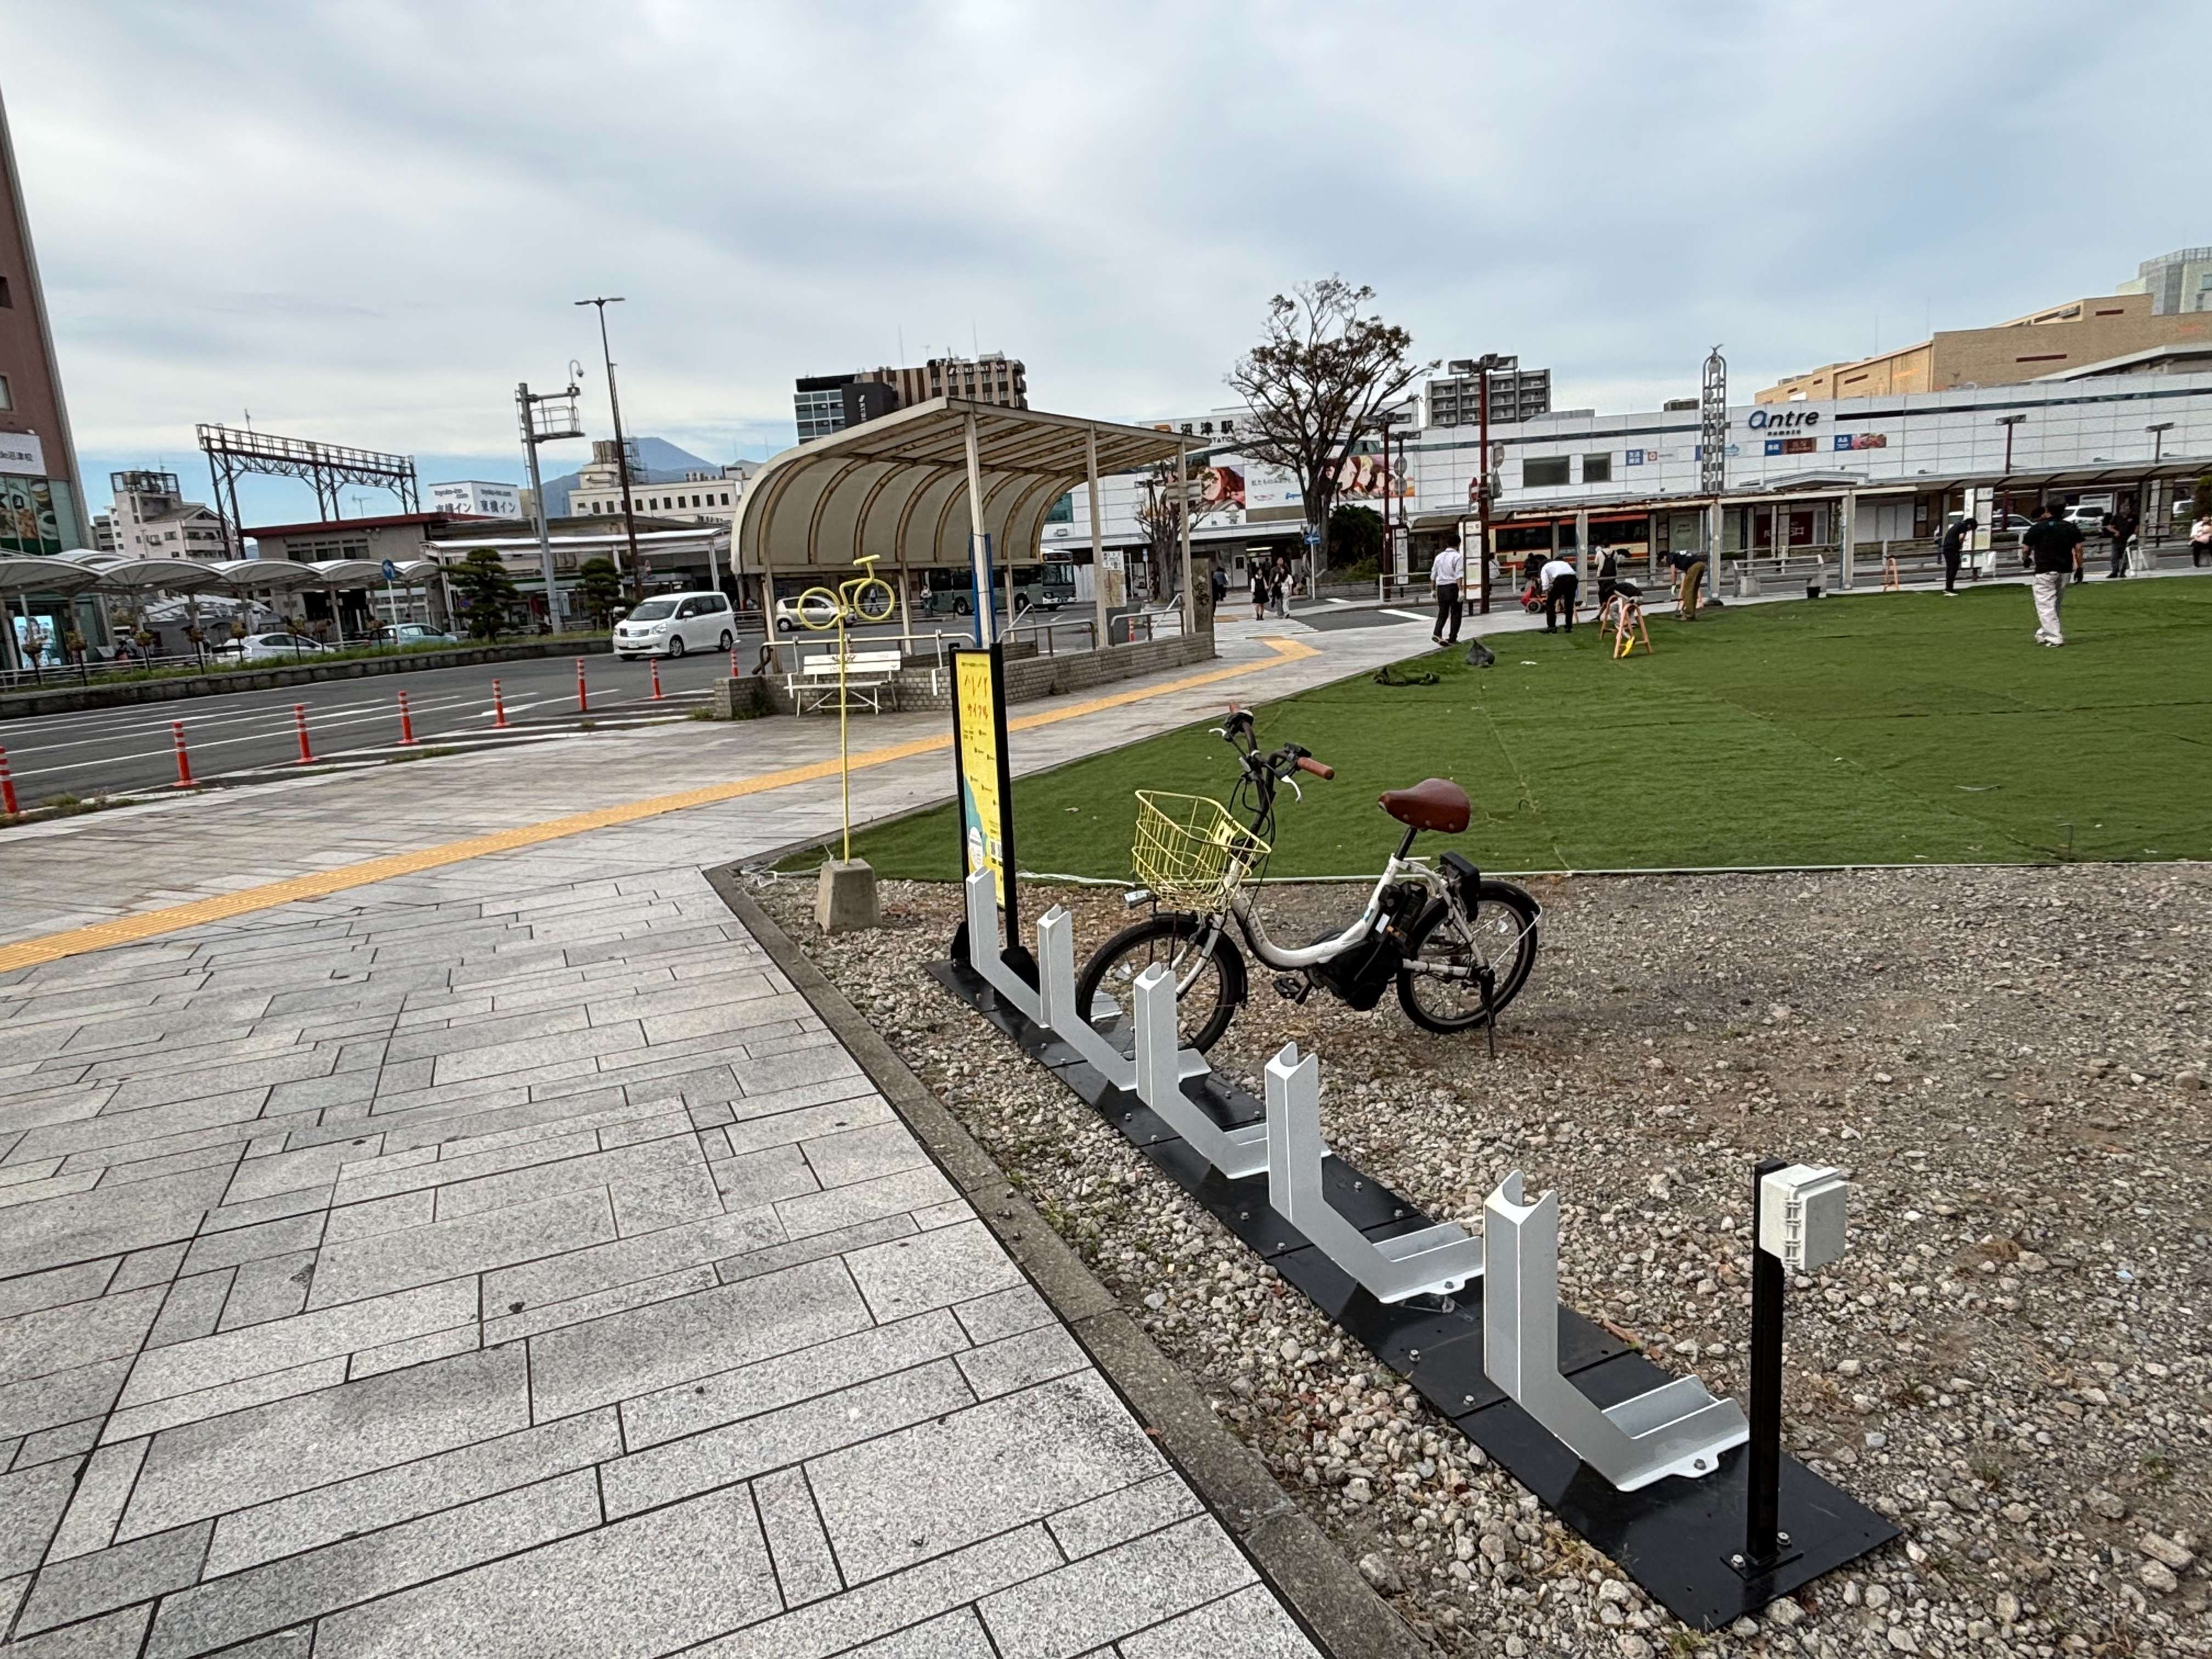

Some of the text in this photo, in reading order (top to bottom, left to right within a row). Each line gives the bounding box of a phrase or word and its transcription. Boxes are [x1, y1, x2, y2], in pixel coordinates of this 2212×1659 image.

[1181, 420, 1235, 436] 沼津駅
[480, 500, 516, 513] 東横イン
